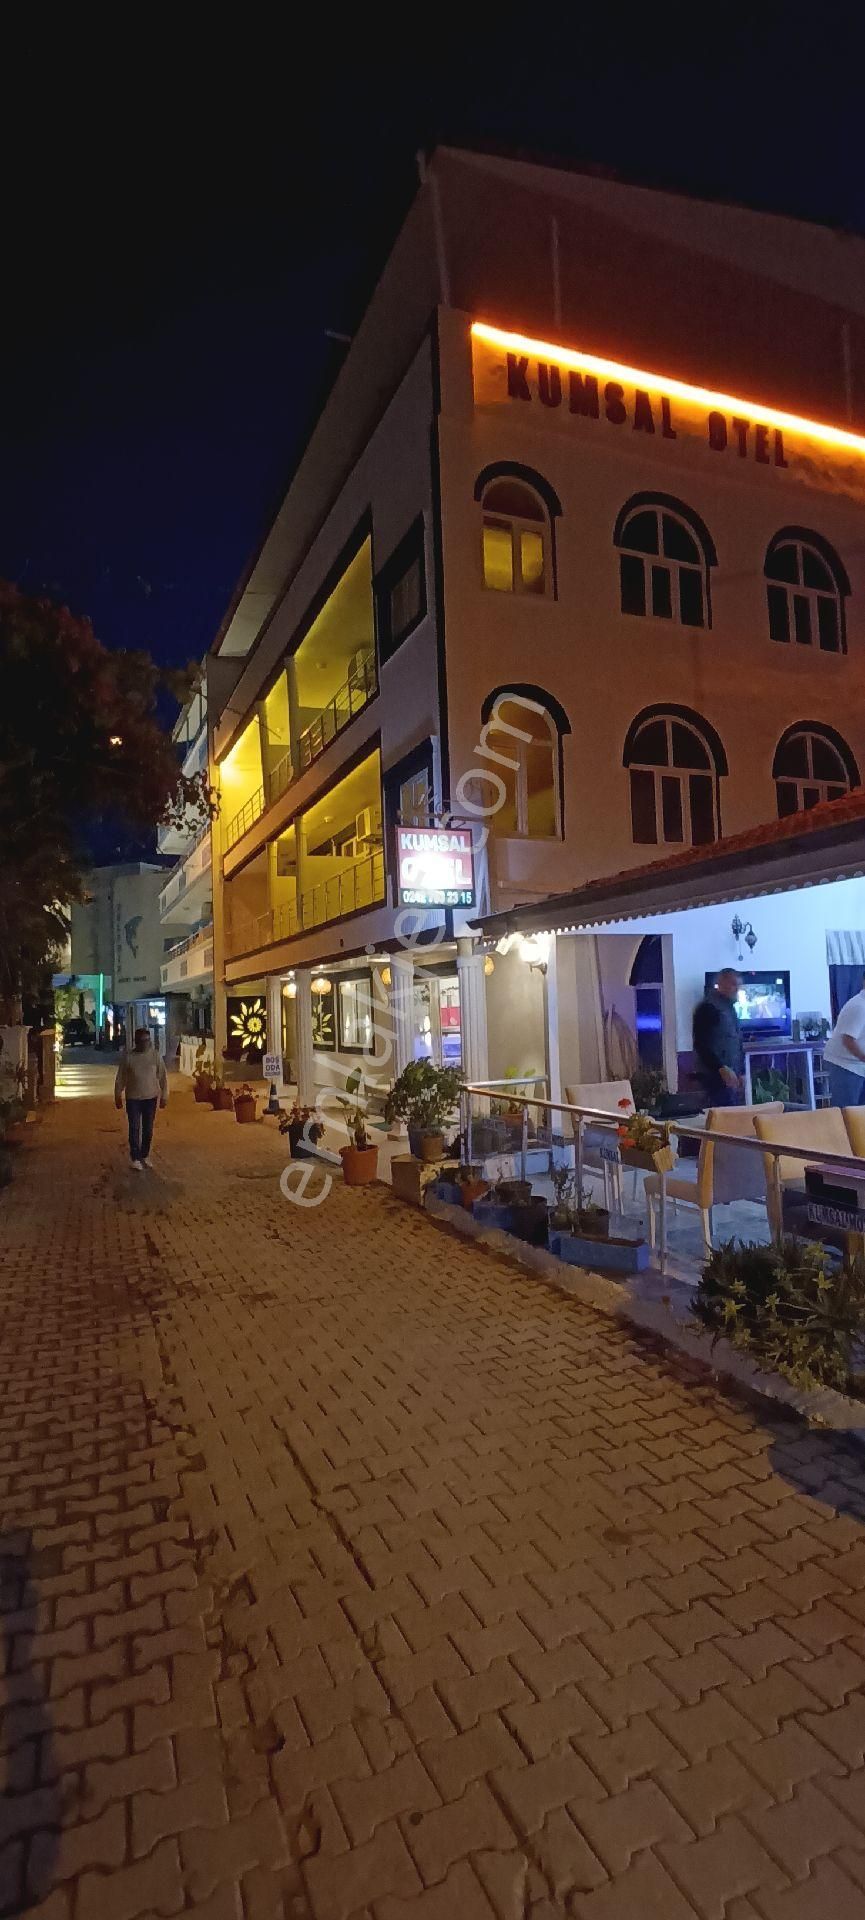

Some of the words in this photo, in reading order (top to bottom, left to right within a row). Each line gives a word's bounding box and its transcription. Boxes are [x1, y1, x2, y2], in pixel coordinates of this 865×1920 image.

[506, 352, 677, 440] KUMSAL
[708, 411, 788, 468] OTEL
[401, 834, 471, 852] KUMSAL
[402, 857, 472, 885] OL
[460, 892, 472, 904] 15
